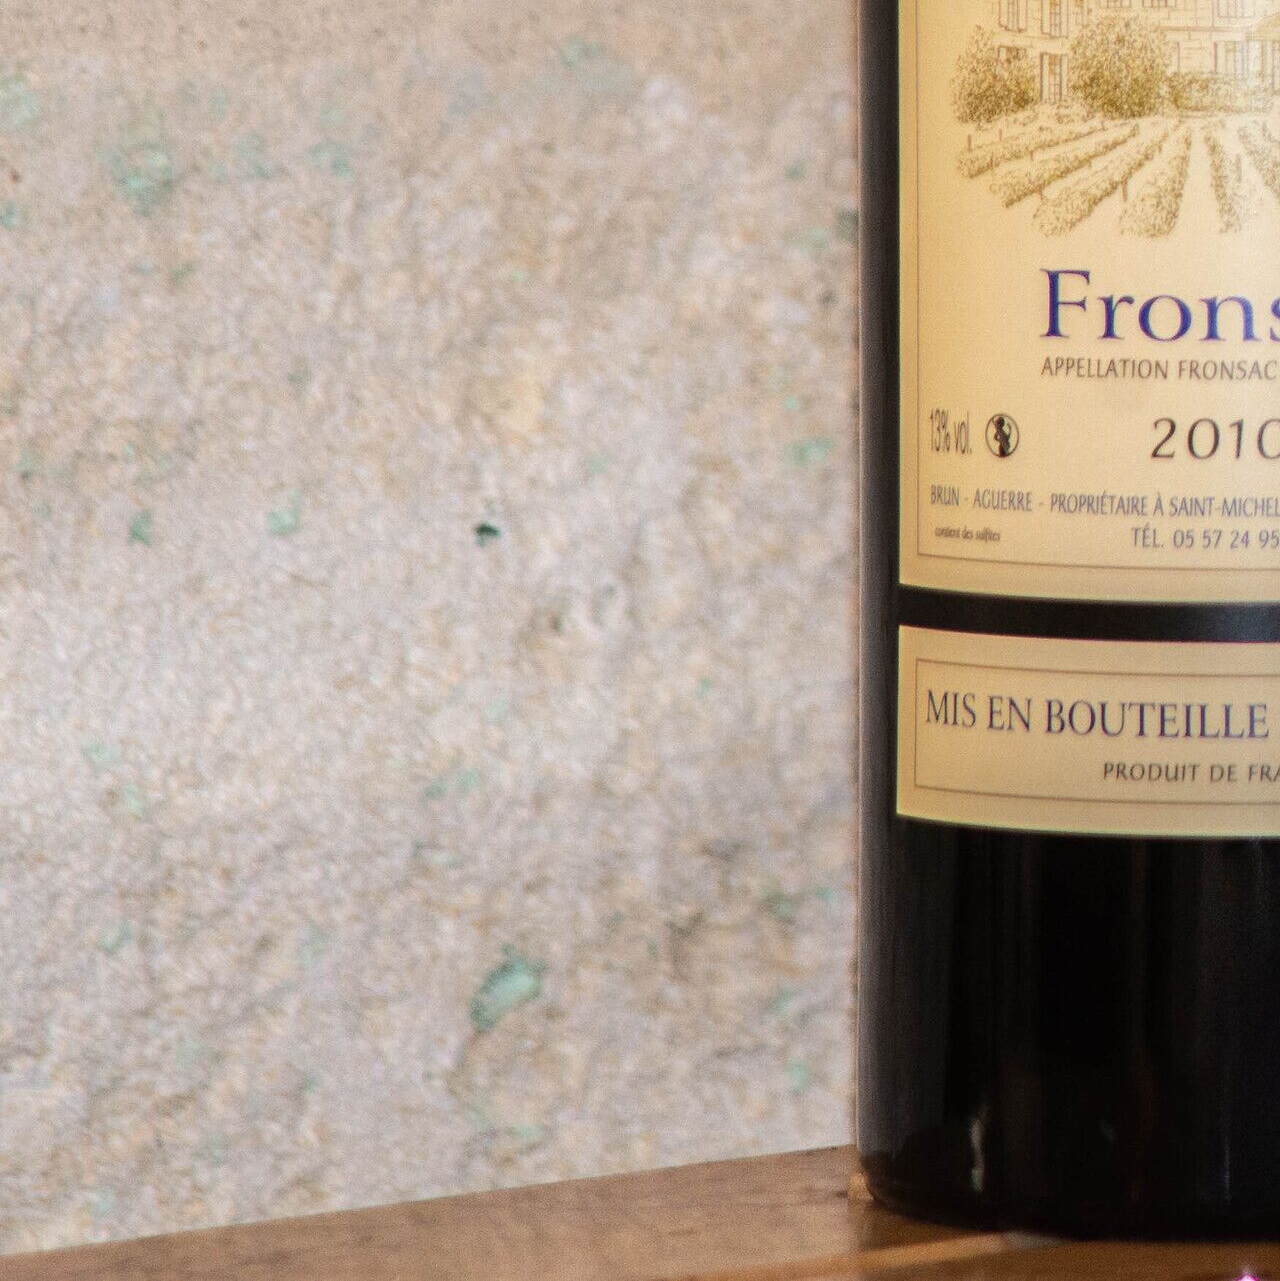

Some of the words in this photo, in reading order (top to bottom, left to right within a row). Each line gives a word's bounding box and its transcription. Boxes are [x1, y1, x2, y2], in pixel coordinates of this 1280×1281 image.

[1040, 356, 1169, 379] APPELLATION
[1178, 358, 1278, 380] FRONSAC
[931, 484, 959, 506] BRUN
[973, 488, 1032, 511] AGUERRE
[1051, 491, 1148, 516] PROPRIÉTAIRE
[1153, 493, 1163, 516] À
[1131, 524, 1163, 548] TÉL.
[1174, 529, 1193, 548] 05
[1202, 529, 1222, 548] 57
[1230, 529, 1249, 549] 24
[1259, 529, 1279, 549] 95
[926, 690, 976, 728] MIS
[987, 695, 1032, 733] EN
[1045, 698, 1269, 739] BOUTEILLE
[1103, 762, 1198, 782] PRODUIT
[1210, 764, 1238, 783] DE
